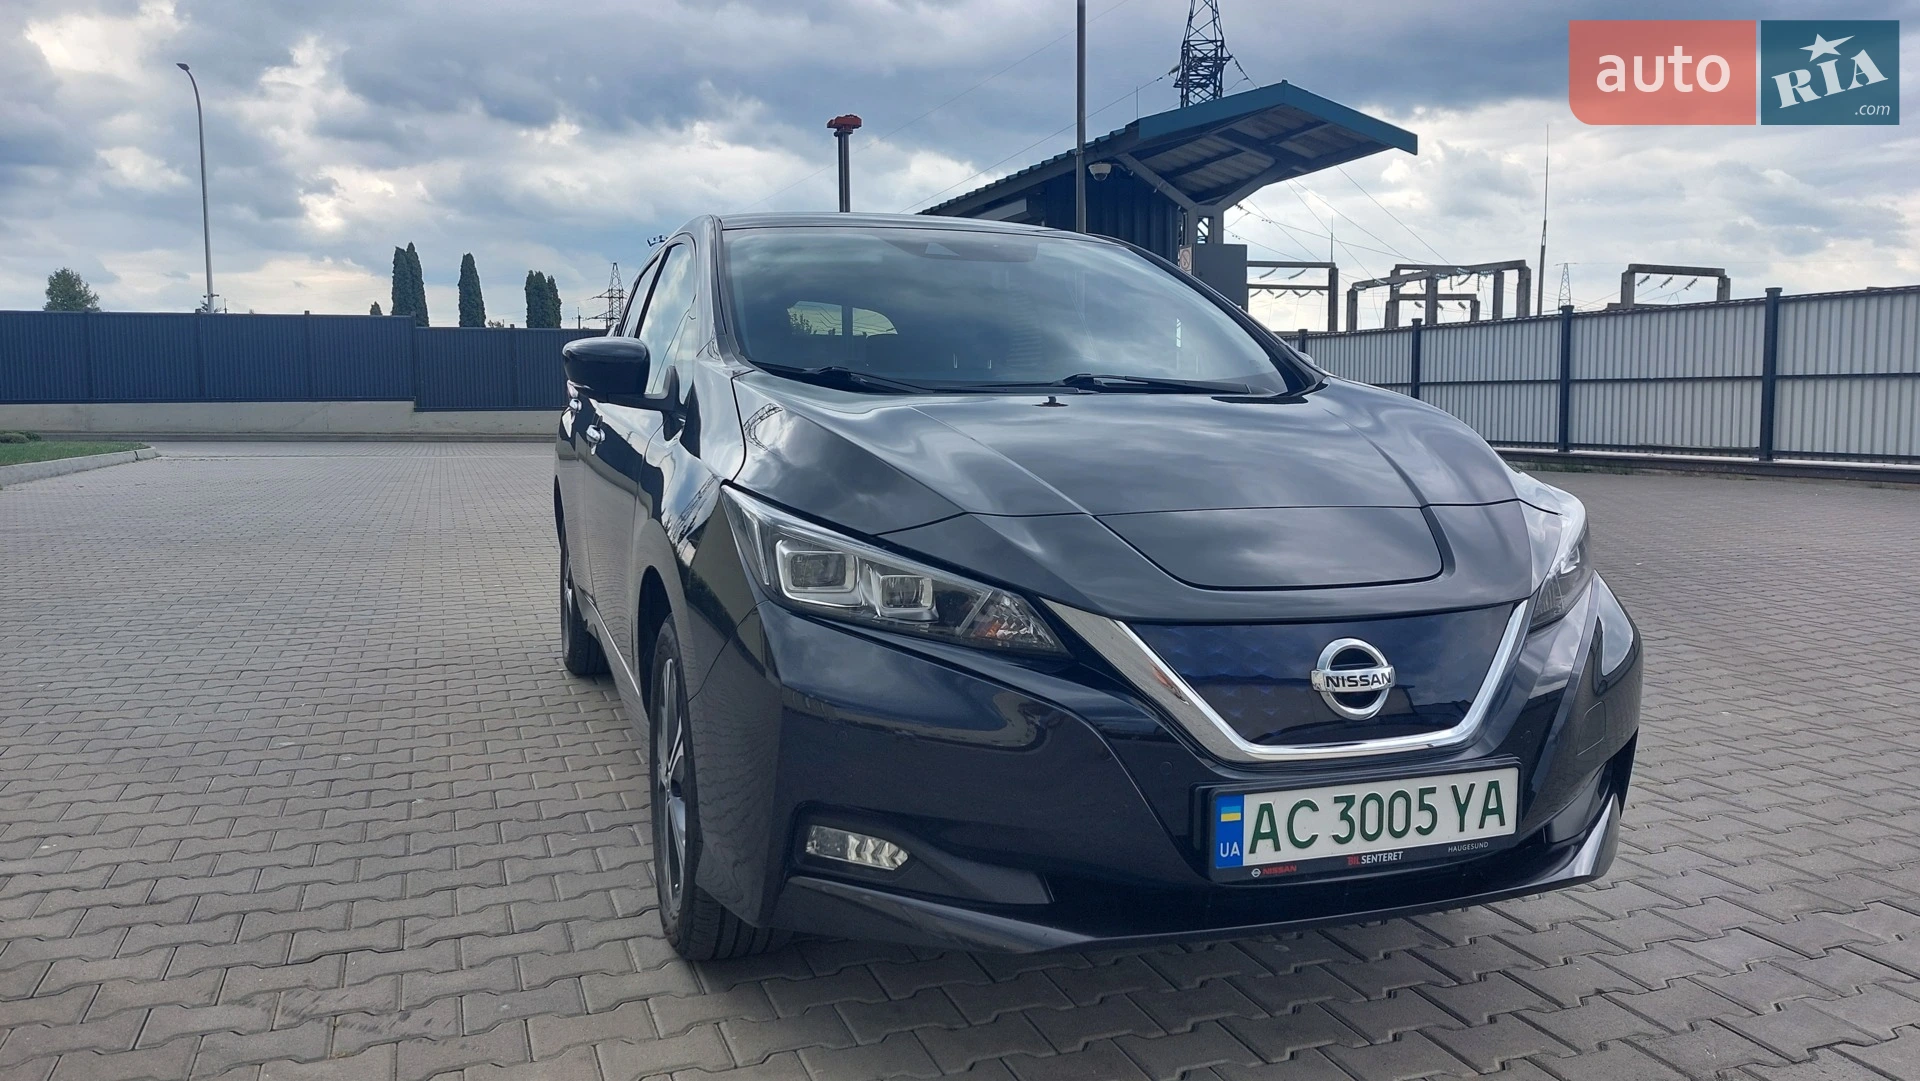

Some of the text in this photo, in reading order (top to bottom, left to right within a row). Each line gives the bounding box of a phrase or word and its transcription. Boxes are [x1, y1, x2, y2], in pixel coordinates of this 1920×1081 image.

[1325, 671, 1391, 688] NISSAN
[1248, 779, 1507, 855] AC 3005 YA
[1220, 841, 1241, 858] UA
[1447, 841, 1489, 853] HAUGESUND
[1262, 865, 1297, 875] NISSAN
